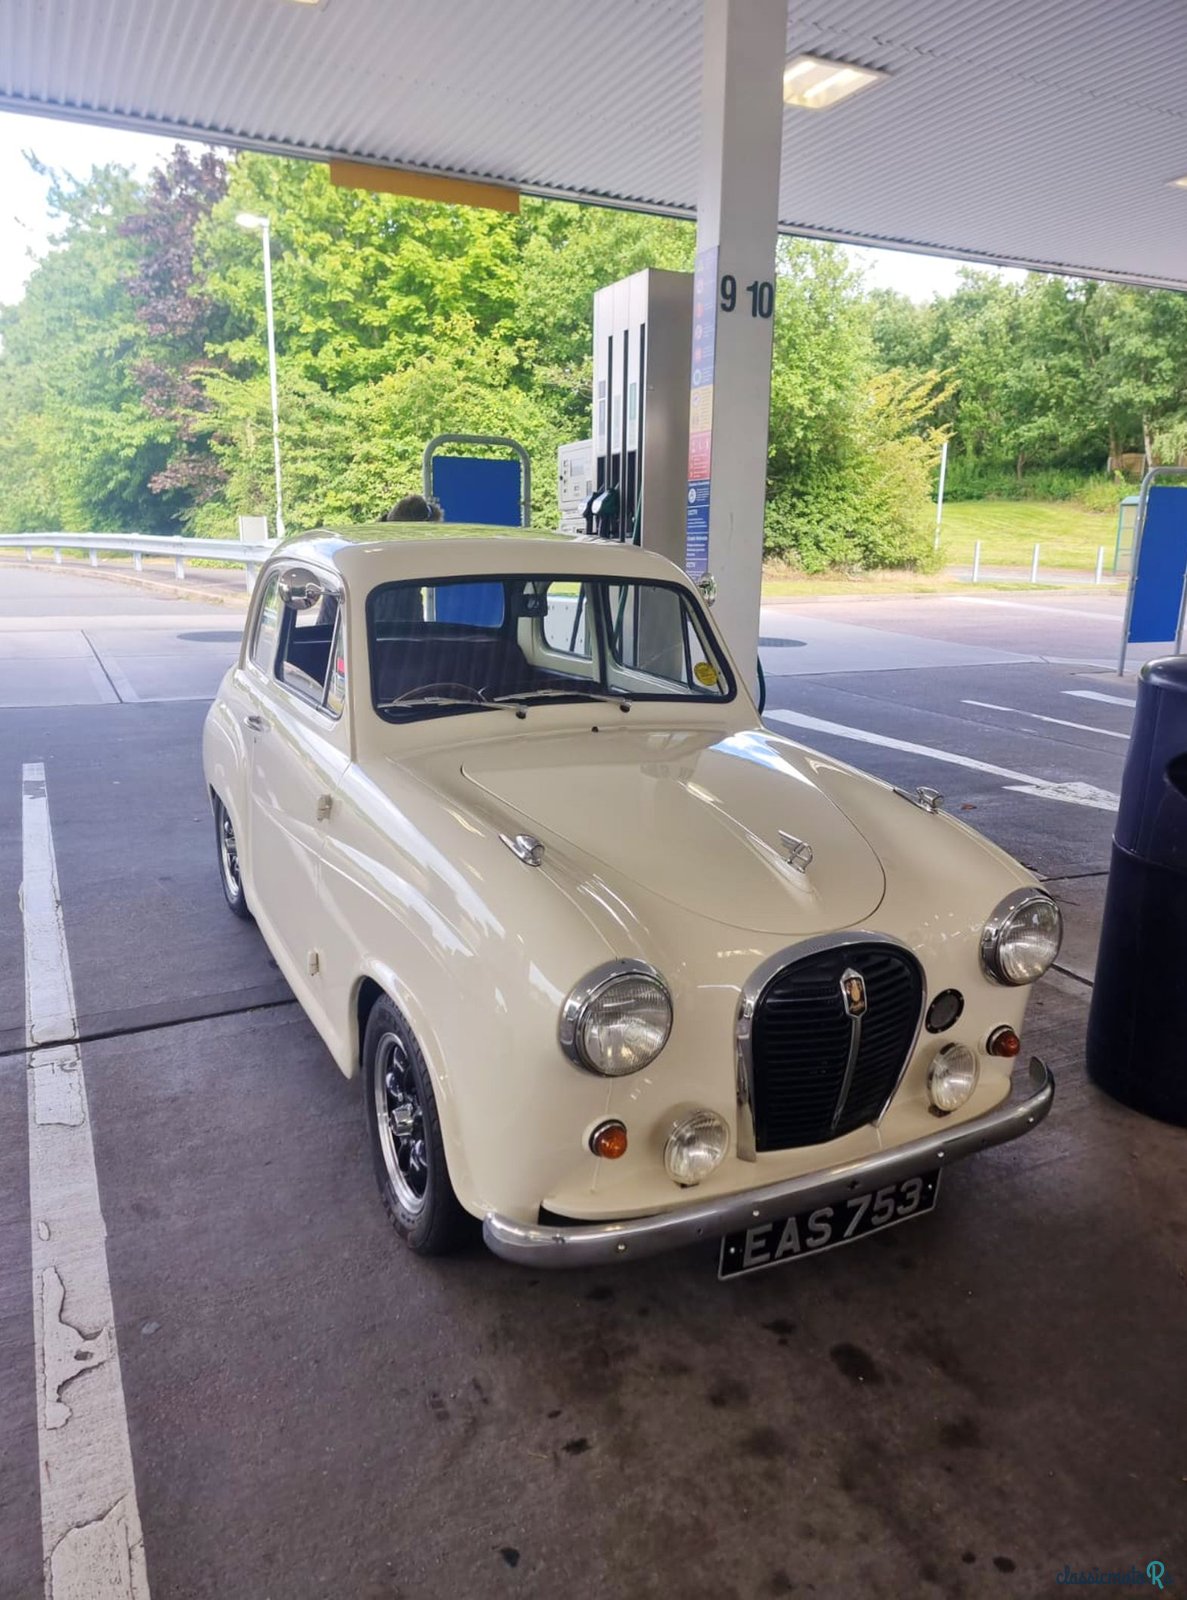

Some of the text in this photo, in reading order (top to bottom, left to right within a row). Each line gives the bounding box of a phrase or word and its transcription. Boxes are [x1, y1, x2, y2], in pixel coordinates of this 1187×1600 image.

[720, 274, 737, 313] 9
[746, 280, 774, 319] 10
[743, 1177, 924, 1268] EAS 753
